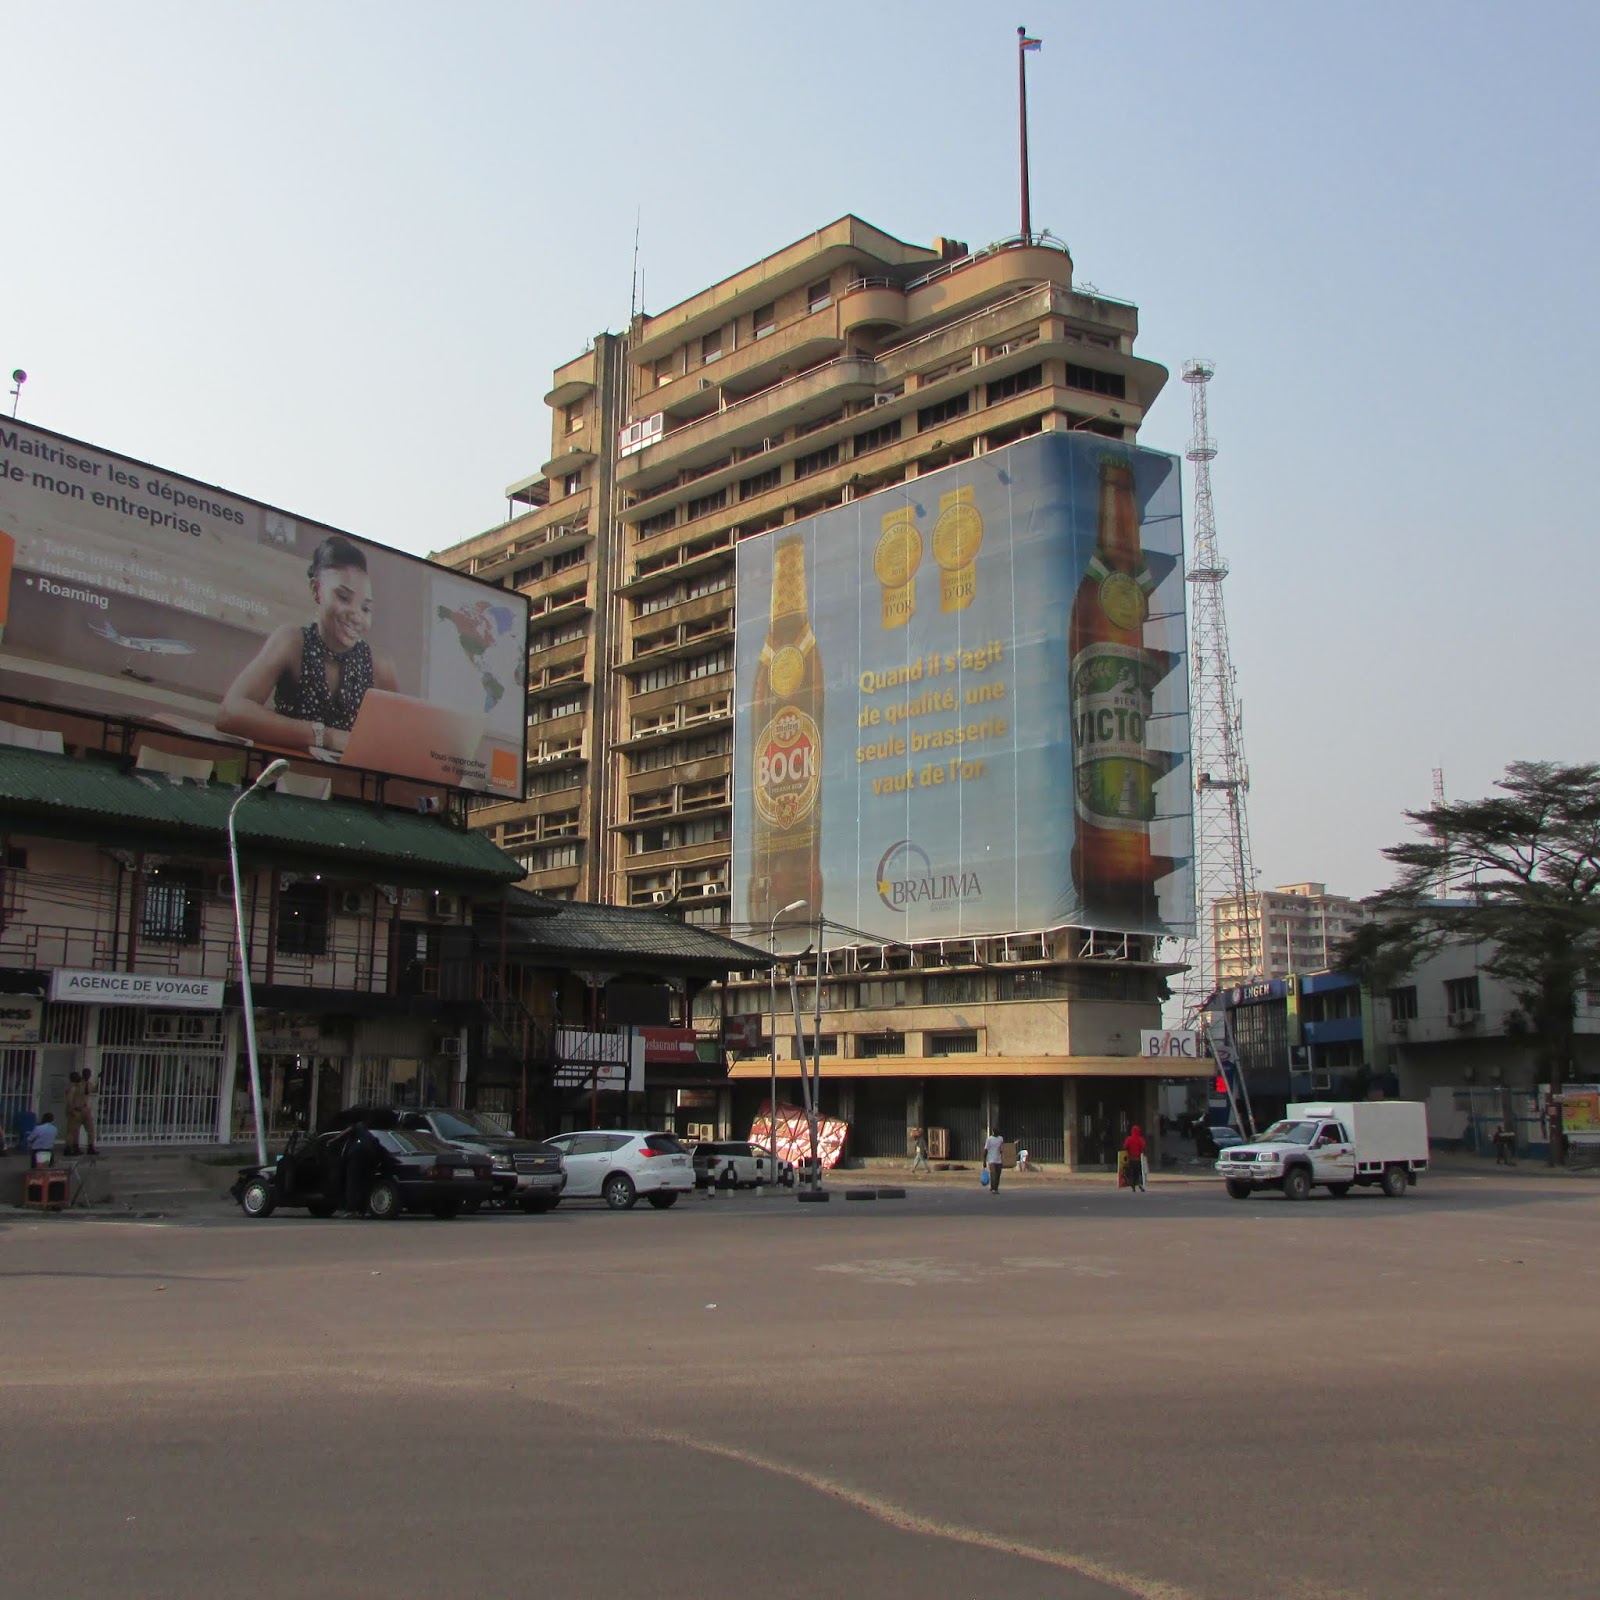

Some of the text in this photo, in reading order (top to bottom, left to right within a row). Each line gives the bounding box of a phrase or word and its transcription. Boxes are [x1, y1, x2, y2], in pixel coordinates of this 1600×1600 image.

[0, 459, 202, 537] de mon entreprise
[108, 464, 140, 490] les
[146, 479, 244, 525] dépenses
[38, 577, 109, 610] Roaming
[41, 559, 103, 585] Internet
[139, 585, 171, 604] haut
[944, 583, 973, 601] D'OR
[885, 601, 912, 618] D'OR
[859, 640, 1003, 694] Quand il s'agit
[857, 680, 1006, 728] de qualité, une
[856, 714, 1008, 764] seule brasserie
[430, 750, 487, 770] Vous rapprocher
[441, 764, 451, 772] de
[757, 746, 817, 788] BOCK
[492, 777, 515, 789] orange
[872, 768, 915, 795] vaut
[919, 762, 945, 787] de
[892, 872, 982, 905] BRALIMA
[69, 976, 209, 996] AGENCE DE VOYAGE
[645, 1039, 678, 1051] estaurant
